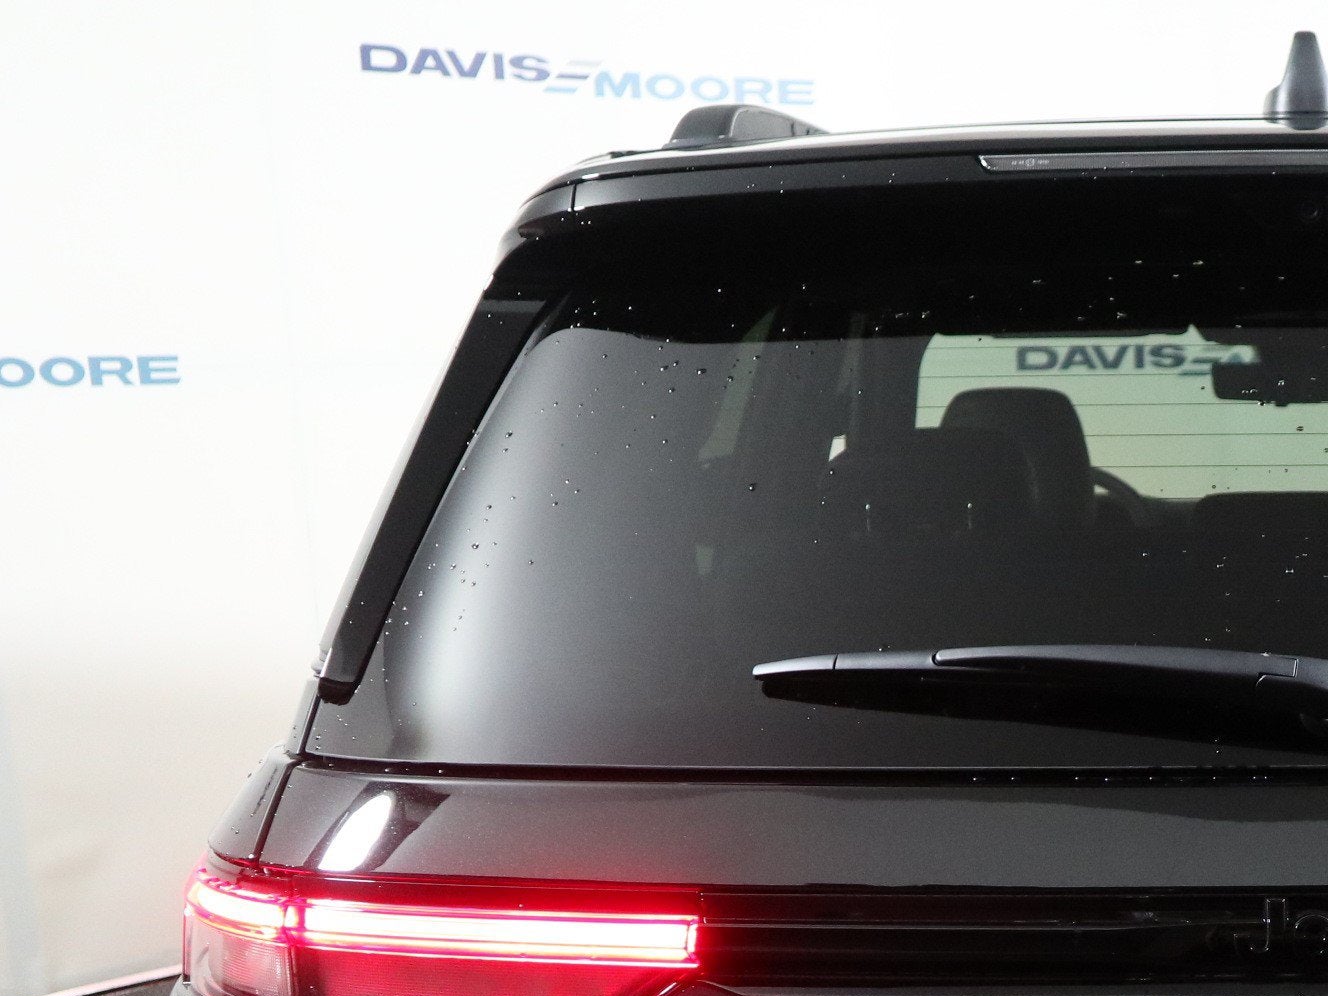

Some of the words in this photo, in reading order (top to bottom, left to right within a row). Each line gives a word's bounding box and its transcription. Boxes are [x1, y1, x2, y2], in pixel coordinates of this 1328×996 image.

[360, 43, 549, 82] DAVIS
[594, 74, 815, 106] MOORE
[1016, 344, 1187, 371] DAVIS
